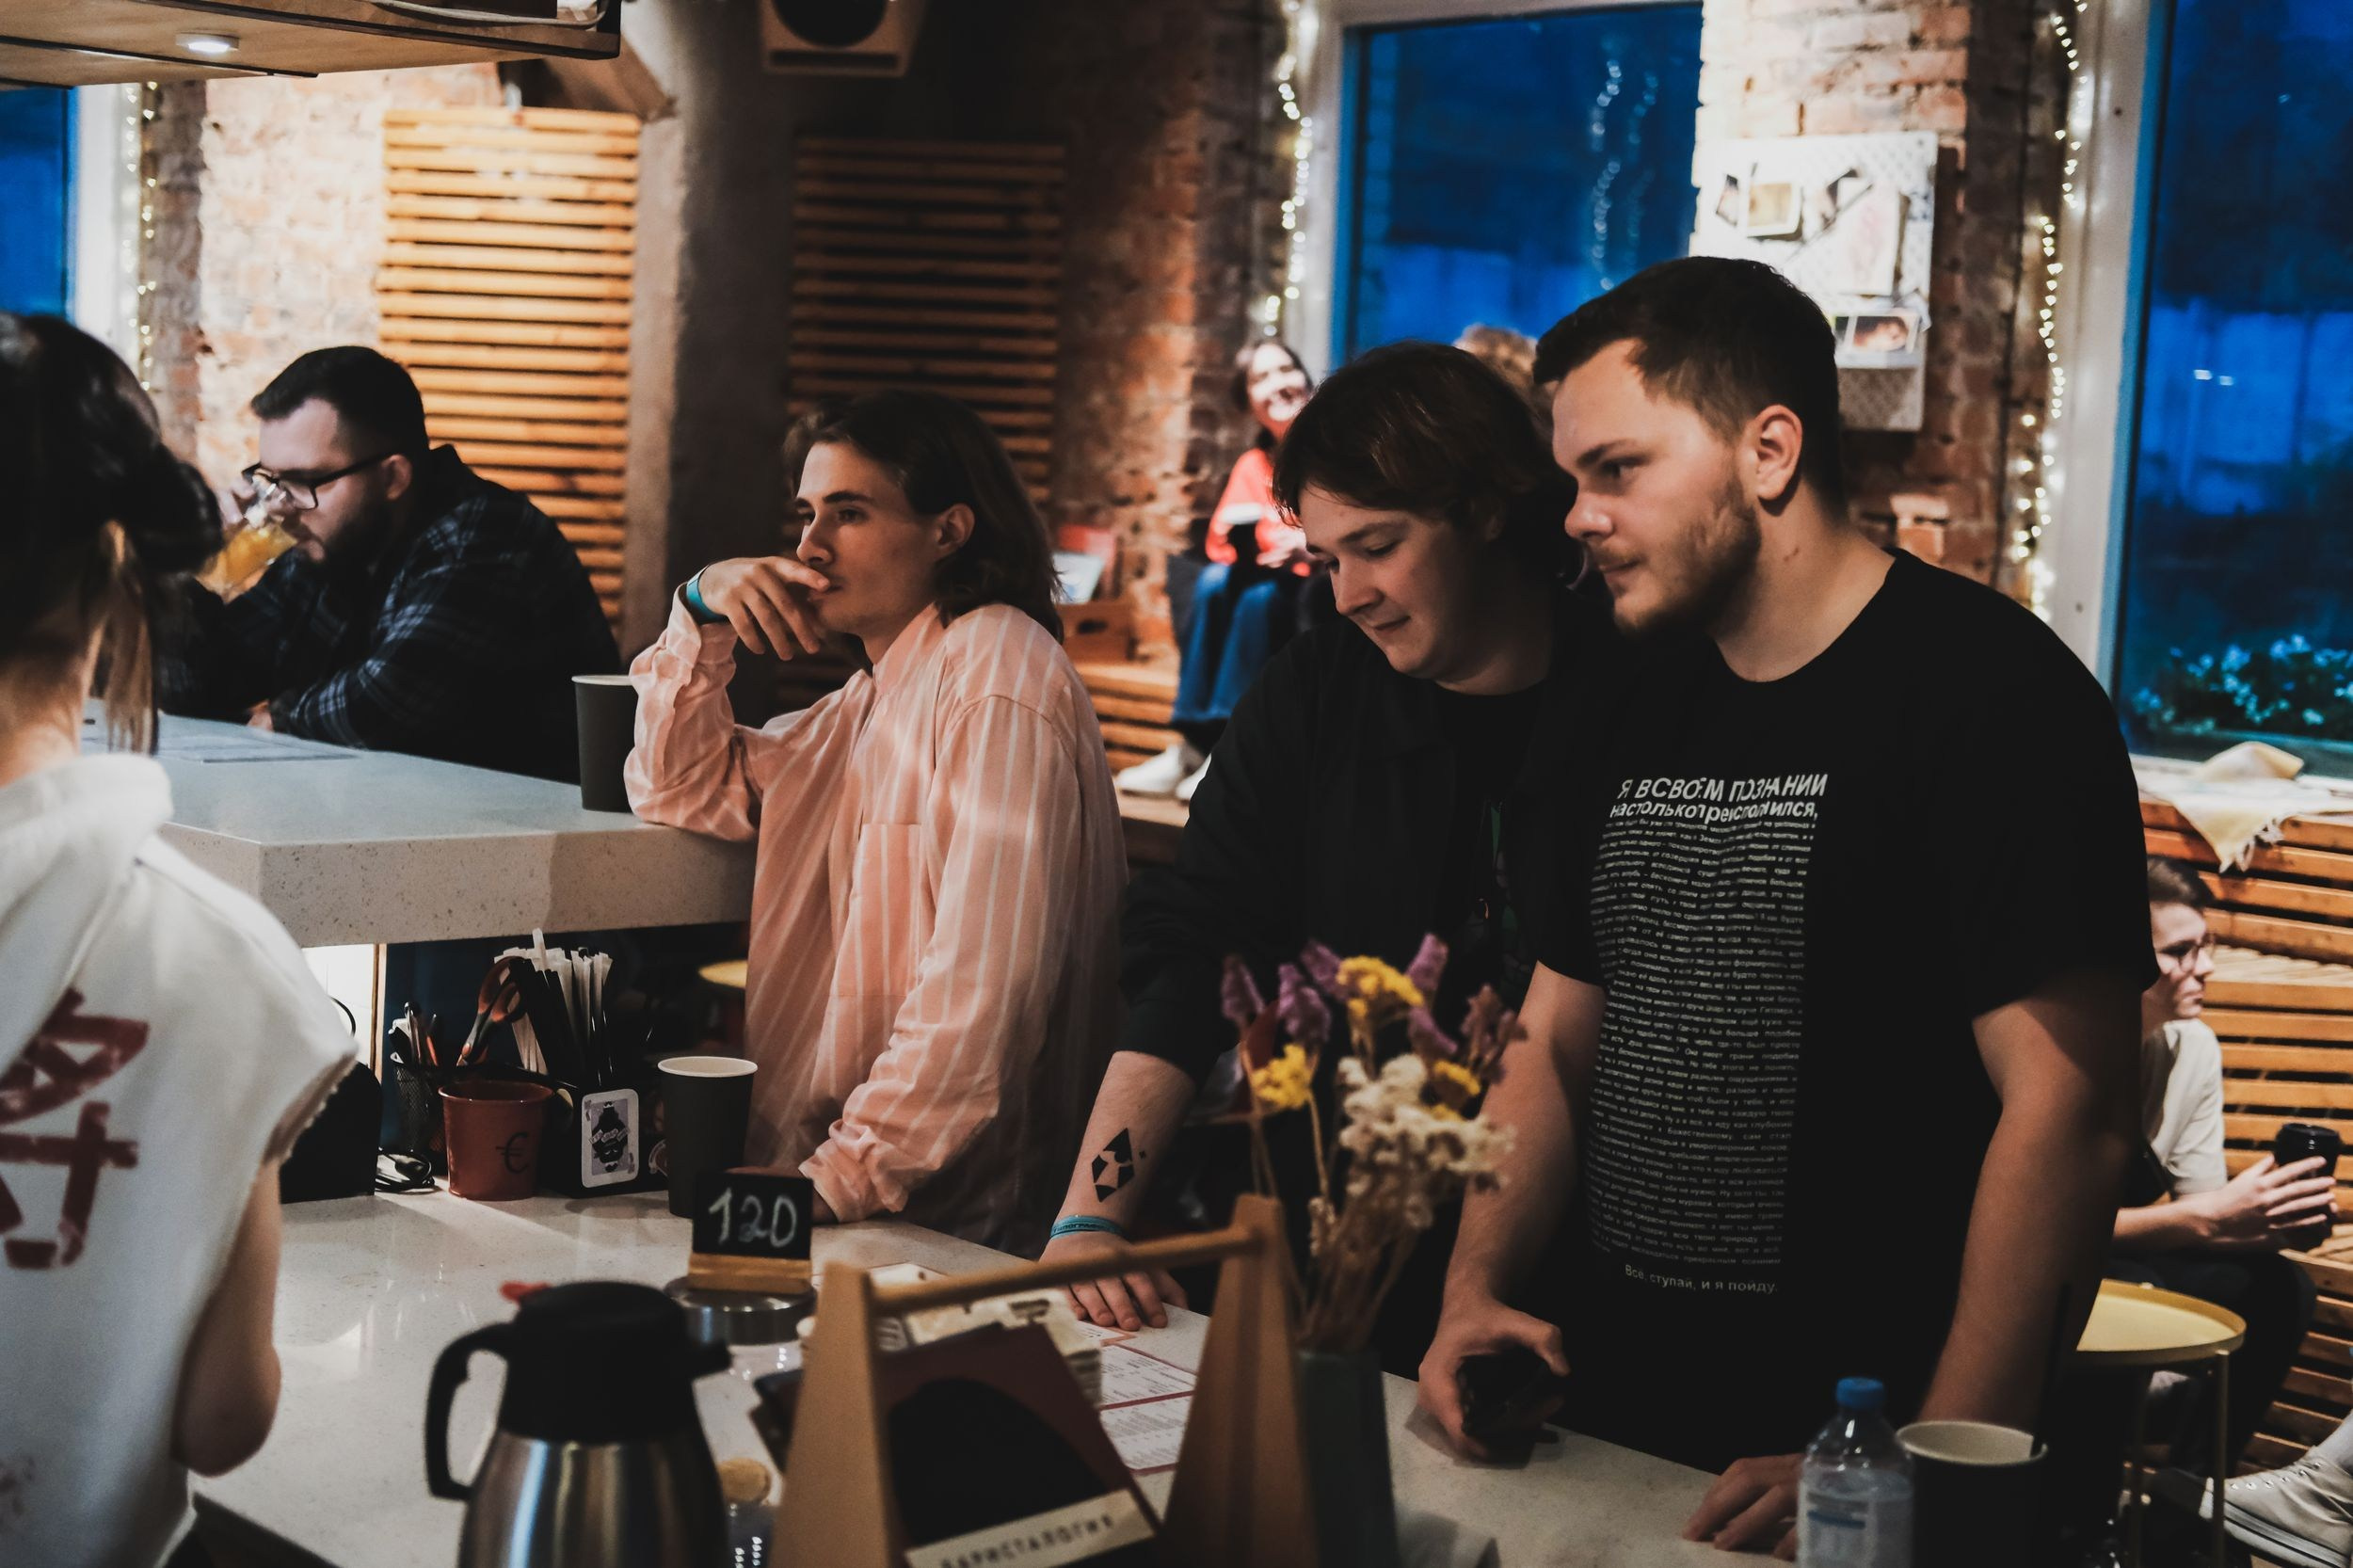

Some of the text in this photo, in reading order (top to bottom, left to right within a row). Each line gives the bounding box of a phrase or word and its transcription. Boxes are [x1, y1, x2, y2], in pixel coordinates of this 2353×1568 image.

[1617, 779, 1633, 799] Я
[708, 1187, 797, 1248] 120
[1701, 1281, 1710, 1289] и
[1715, 1281, 1723, 1290] я
